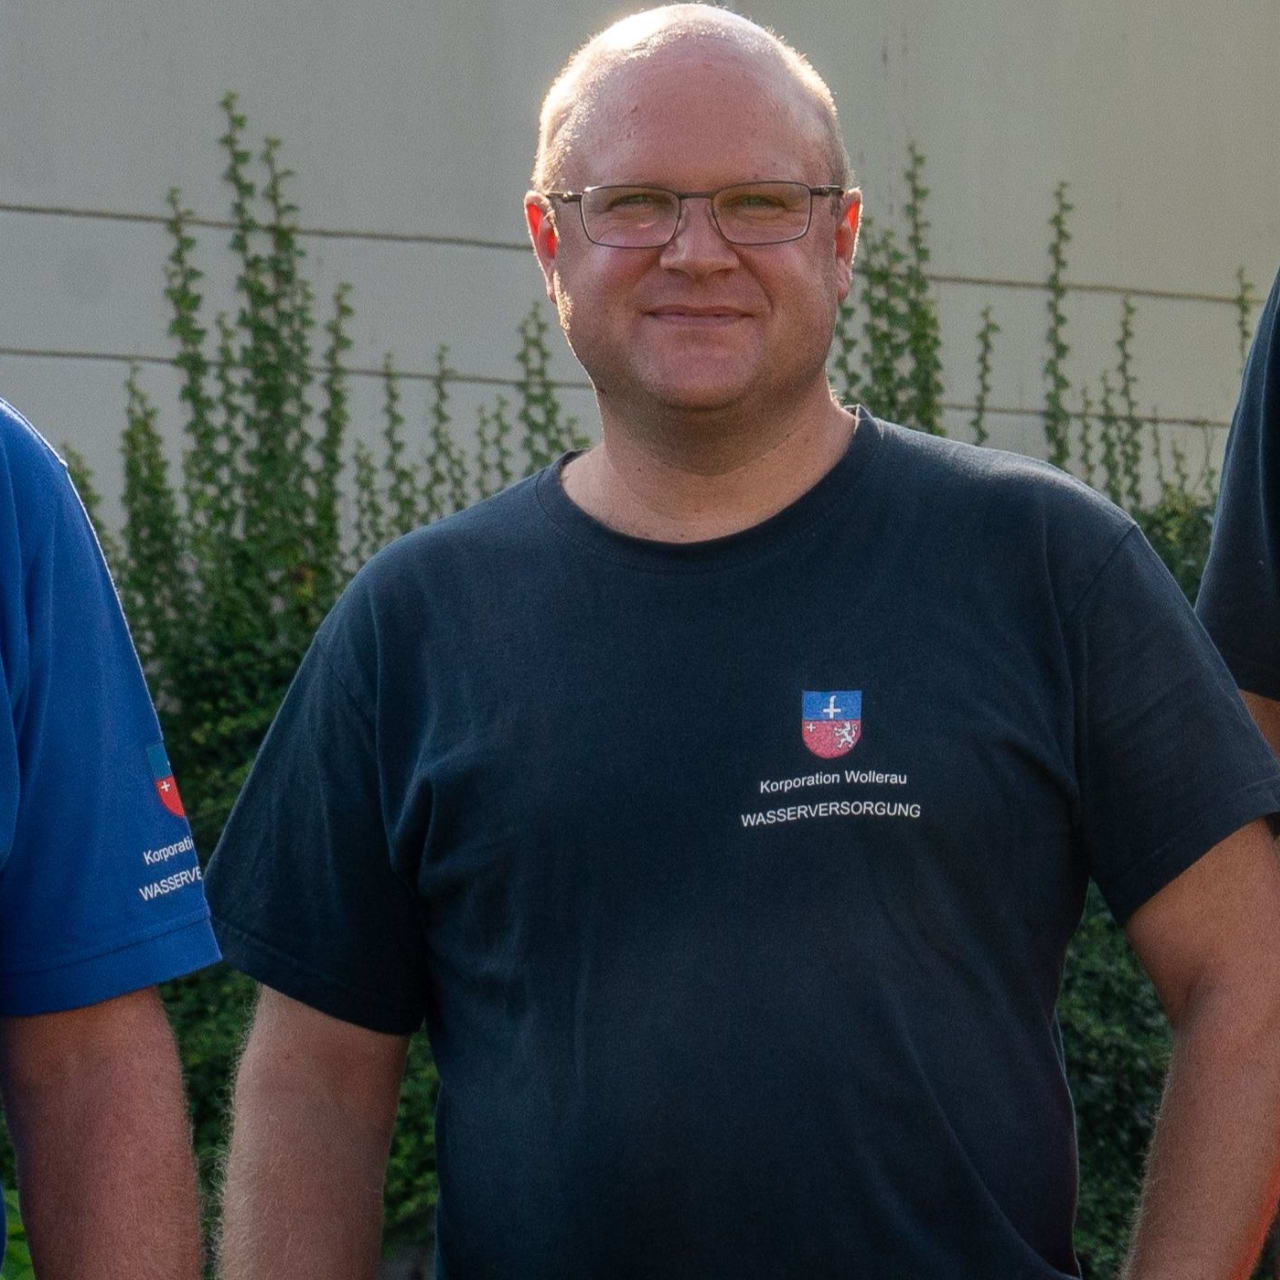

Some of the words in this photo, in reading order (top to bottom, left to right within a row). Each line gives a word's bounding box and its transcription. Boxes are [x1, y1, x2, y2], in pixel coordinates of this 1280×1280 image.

[760, 771, 840, 793] Korporation
[845, 770, 907, 784] Wollerau
[741, 801, 921, 827] WASSERVERSORGUNG
[143, 835, 194, 865] Korporati
